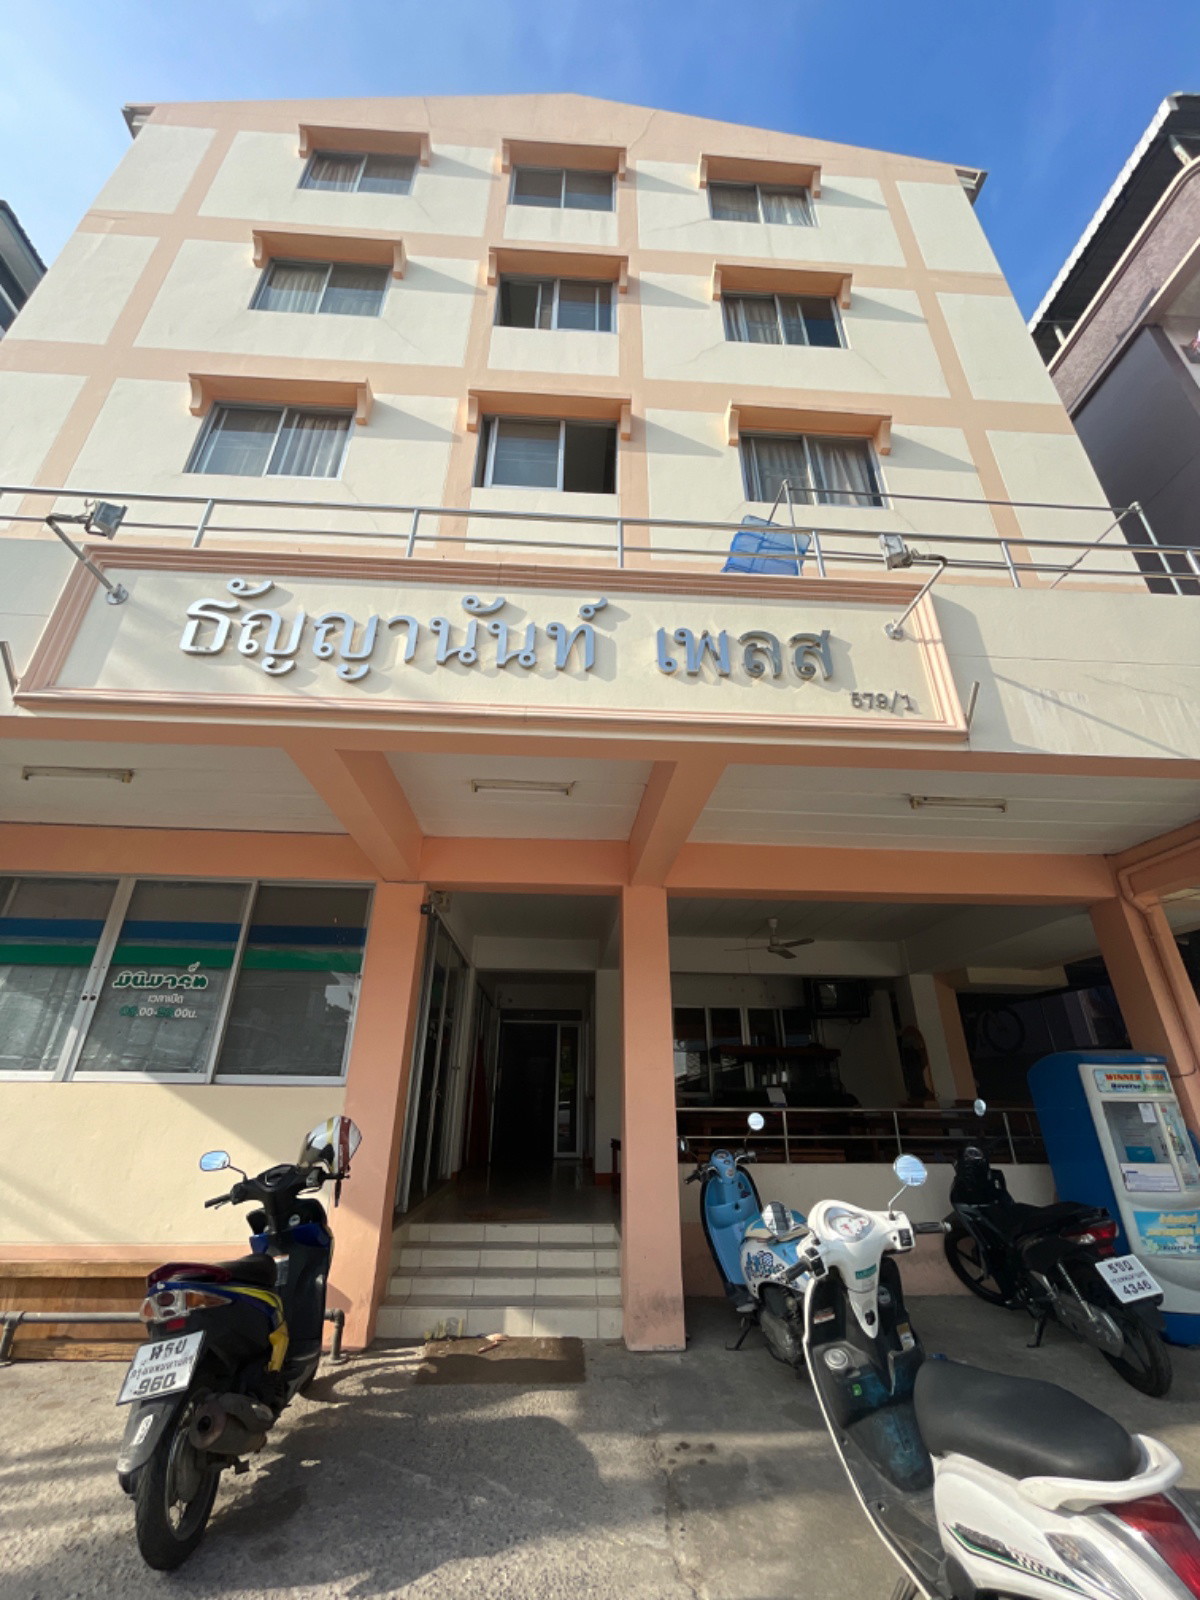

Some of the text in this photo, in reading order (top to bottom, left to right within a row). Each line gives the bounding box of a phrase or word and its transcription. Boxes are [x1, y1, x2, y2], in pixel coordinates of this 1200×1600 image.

[179, 577, 834, 682] ธัญญานันท์ เพลส
[133, 1373, 177, 1396] 960
